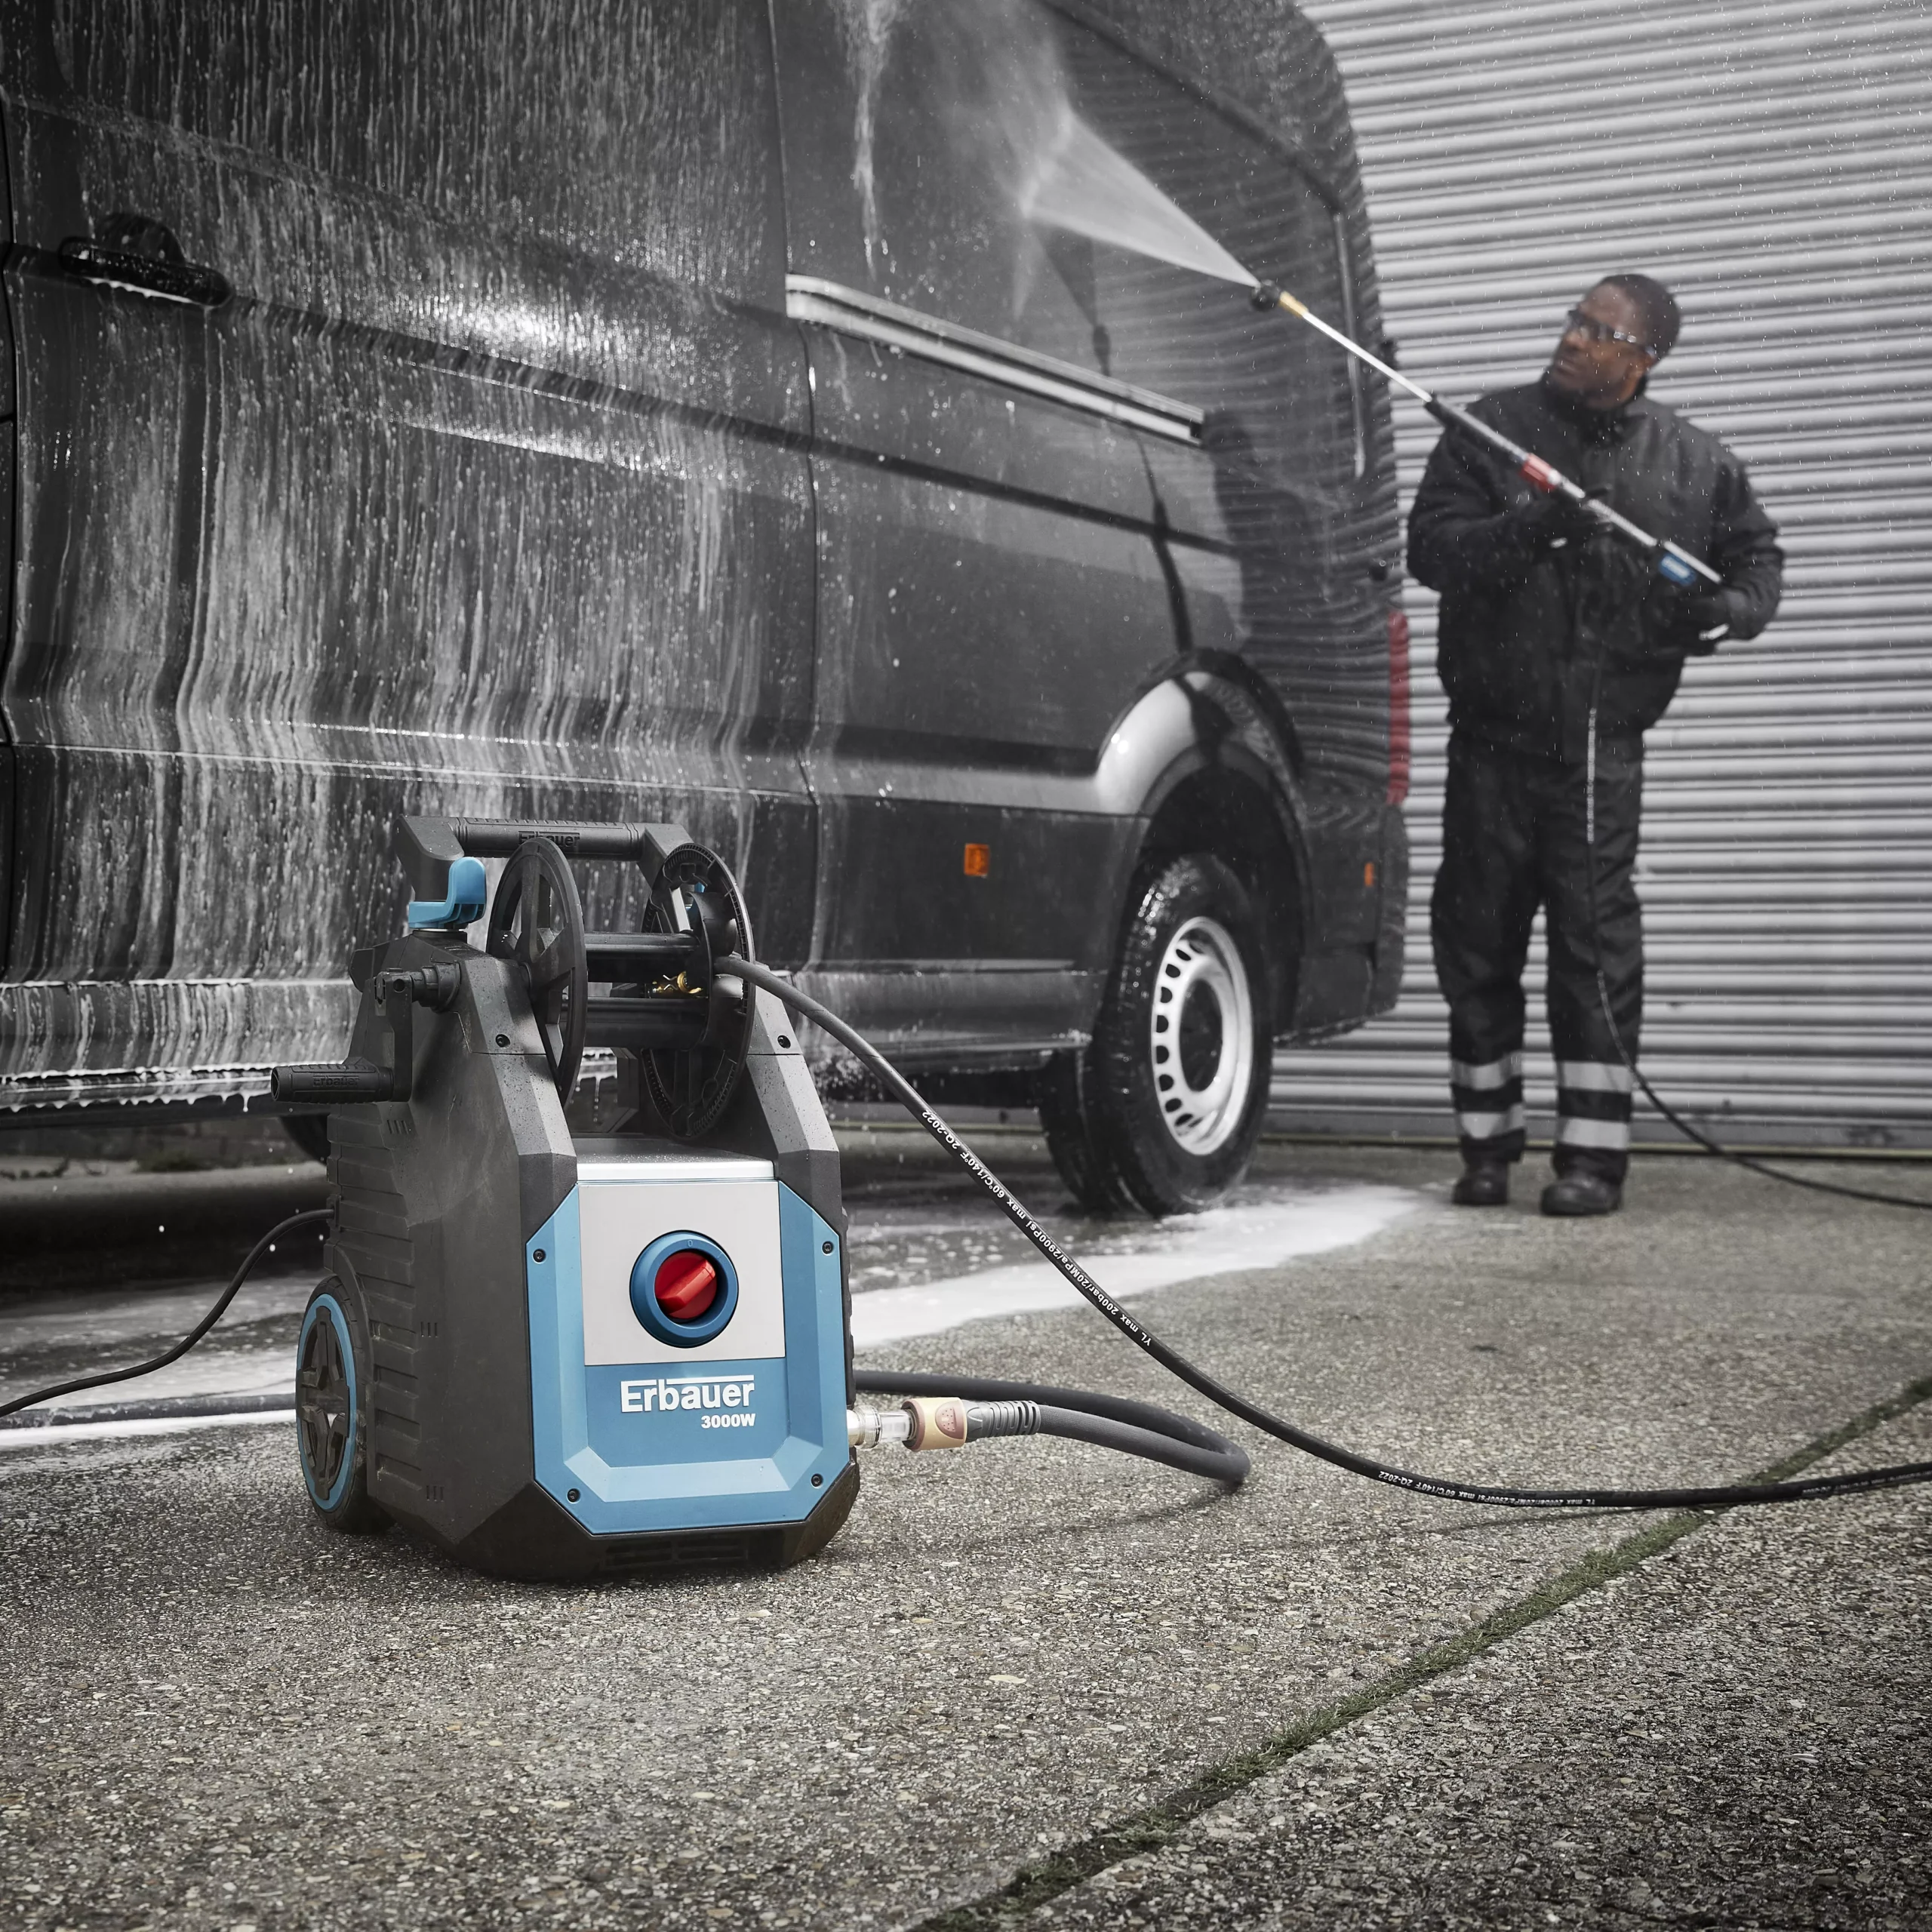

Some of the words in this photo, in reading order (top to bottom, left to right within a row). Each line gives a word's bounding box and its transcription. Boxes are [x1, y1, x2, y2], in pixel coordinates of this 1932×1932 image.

[921, 1109, 961, 1149] 2Q-2022
[959, 1152, 1005, 1198] 60°C/140°F
[1006, 1198, 1026, 1219] max
[1025, 1220, 1119, 1315] 200bar/20MPa/2900Psi
[1119, 1314, 1139, 1332] max
[1141, 1332, 1152, 1346] YL
[620, 1374, 755, 1413] Erbauer
[700, 1413, 756, 1429] 3000W
[1378, 1470, 1414, 1487] 2Q-2022
[1458, 1491, 1475, 1500] max
